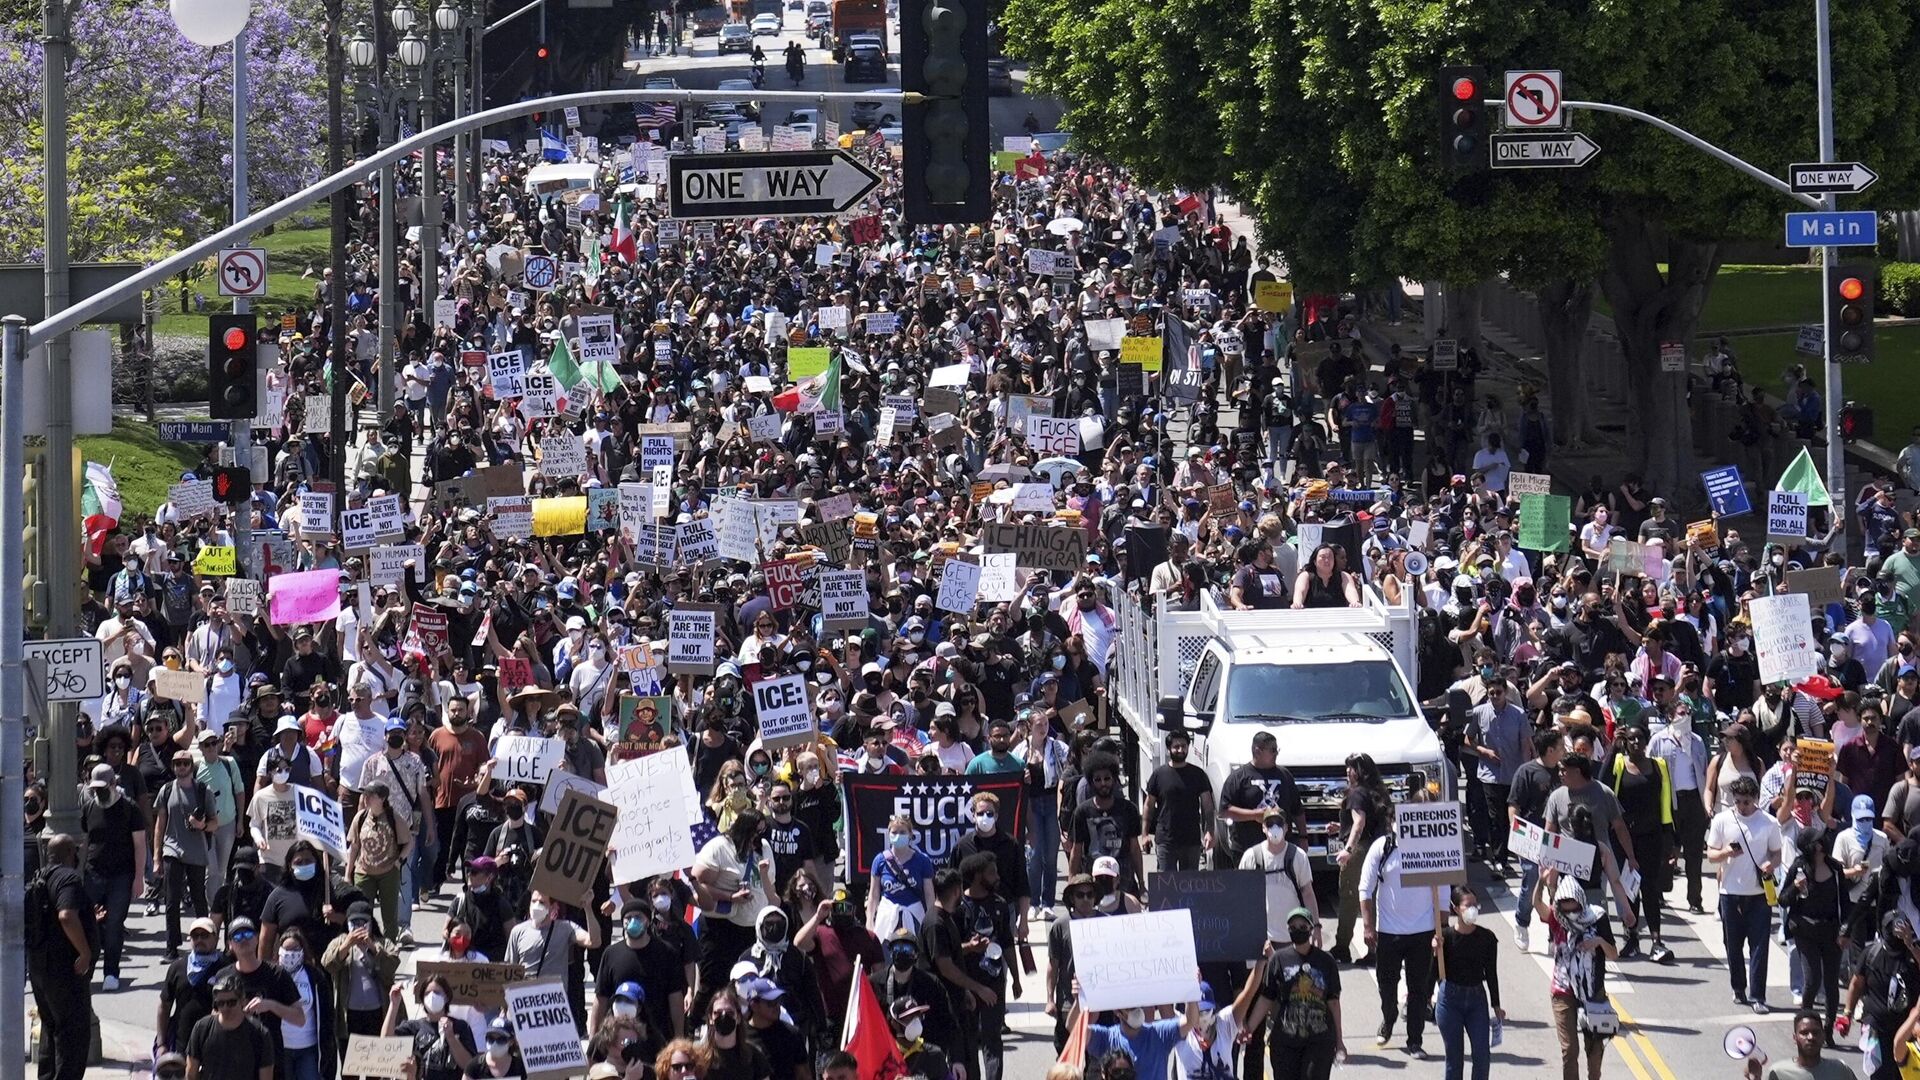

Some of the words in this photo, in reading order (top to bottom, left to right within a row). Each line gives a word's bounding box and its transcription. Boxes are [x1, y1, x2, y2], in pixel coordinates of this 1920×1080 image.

[1499, 144, 1530, 159] ONE
[1541, 142, 1573, 158] WAY
[686, 171, 745, 200] ONE
[766, 169, 829, 198] WAY
[1800, 173, 1825, 185] ONE
[1828, 172, 1852, 184] WAY
[1802, 219, 1861, 237] Main
[1055, 257, 1073, 268] ICE:
[584, 348, 615, 358] DEVIL!
[490, 354, 520, 370] ICE
[525, 376, 553, 389] ICE
[541, 397, 555, 415] LA
[160, 423, 187, 433] North
[191, 424, 213, 434] Main
[1040, 419, 1077, 436] FUCK
[648, 438, 668, 447] FULL
[1039, 436, 1077, 455] ICE
[643, 447, 672, 456] RIGHTS
[544, 467, 573, 475] ABOLISH
[1511, 474, 1525, 484] Poli
[1328, 492, 1371, 501] SALVADOR
[1777, 494, 1800, 505] FULL
[303, 501, 313, 509] ARE
[315, 501, 327, 509] THE
[371, 505, 382, 513] ARE
[384, 503, 396, 511] THE
[1770, 504, 1805, 516] RIGHTS
[308, 518, 321, 526] NOT
[379, 520, 392, 529] NOT
[623, 511, 636, 525] Only
[1770, 519, 1787, 528] FOR
[1789, 520, 1804, 529] ALL
[683, 522, 706, 535] FULL
[1301, 525, 1320, 541] NO
[680, 531, 714, 547] RIGHTS
[204, 547, 222, 557] OUT
[371, 551, 382, 559] NO
[385, 550, 410, 559] HUMAN
[412, 547, 423, 557] IS
[702, 544, 717, 556] ALL
[206, 560, 236, 573] ANGELES!
[983, 555, 1013, 567] ICE
[764, 563, 800, 585] FUCK
[822, 573, 863, 582] BILLIONAIRES
[945, 562, 977, 580] GET
[825, 582, 844, 592] ARE
[845, 581, 862, 590] THE
[949, 579, 967, 589] THE
[768, 582, 803, 609] ICE
[841, 590, 865, 598] ENEMY,
[941, 584, 972, 599] FUCK
[232, 597, 253, 612] ICE
[835, 601, 855, 612] NOT
[941, 596, 966, 609] OUT
[825, 611, 866, 620] IMMIGRANTS!
[673, 623, 691, 632] ARE
[693, 622, 711, 632] THE
[688, 633, 712, 641] ENEMY,
[32, 647, 93, 665] EXCEPT
[681, 644, 701, 655] NOT
[625, 644, 656, 670] ICE
[757, 682, 803, 711] ICE:
[762, 718, 777, 729] OUT
[780, 716, 789, 725] OF
[791, 713, 808, 723] OUR
[763, 722, 809, 736] COMMUNITIES!
[510, 739, 548, 755] ABOLISH
[620, 742, 634, 750] NOT
[634, 742, 647, 750] ONE
[508, 756, 545, 780] I.C.E.
[1816, 773, 1829, 781] GO
[611, 781, 655, 805] Fight
[298, 791, 340, 828] ICE:
[893, 796, 975, 825] FUCK
[1400, 809, 1457, 824] ¡DERECHOS
[560, 798, 616, 848] ICE
[625, 815, 653, 838] not
[1400, 823, 1458, 839] PLENOS
[1529, 827, 1539, 842] to
[769, 840, 799, 854] TRUMP
[876, 827, 974, 856] TRUM
[545, 839, 599, 884] OUT
[1401, 852, 1421, 860] PARA
[1422, 851, 1446, 859] TODOS
[1402, 859, 1462, 870] INMIGRANTES!
[1574, 864, 1590, 878] GO
[1157, 874, 1226, 892] Morons
[1122, 915, 1175, 935] MELTS
[471, 967, 496, 982] ONE
[504, 968, 526, 981] US
[459, 984, 479, 998] US
[513, 990, 566, 1013] ¡DERECHOS
[516, 1007, 572, 1031] PLENOS
[524, 1045, 544, 1057] PARA
[544, 1043, 566, 1053] TODOS
[566, 1040, 580, 1051] LOS
[526, 1050, 583, 1068] INMIGRANTES!
